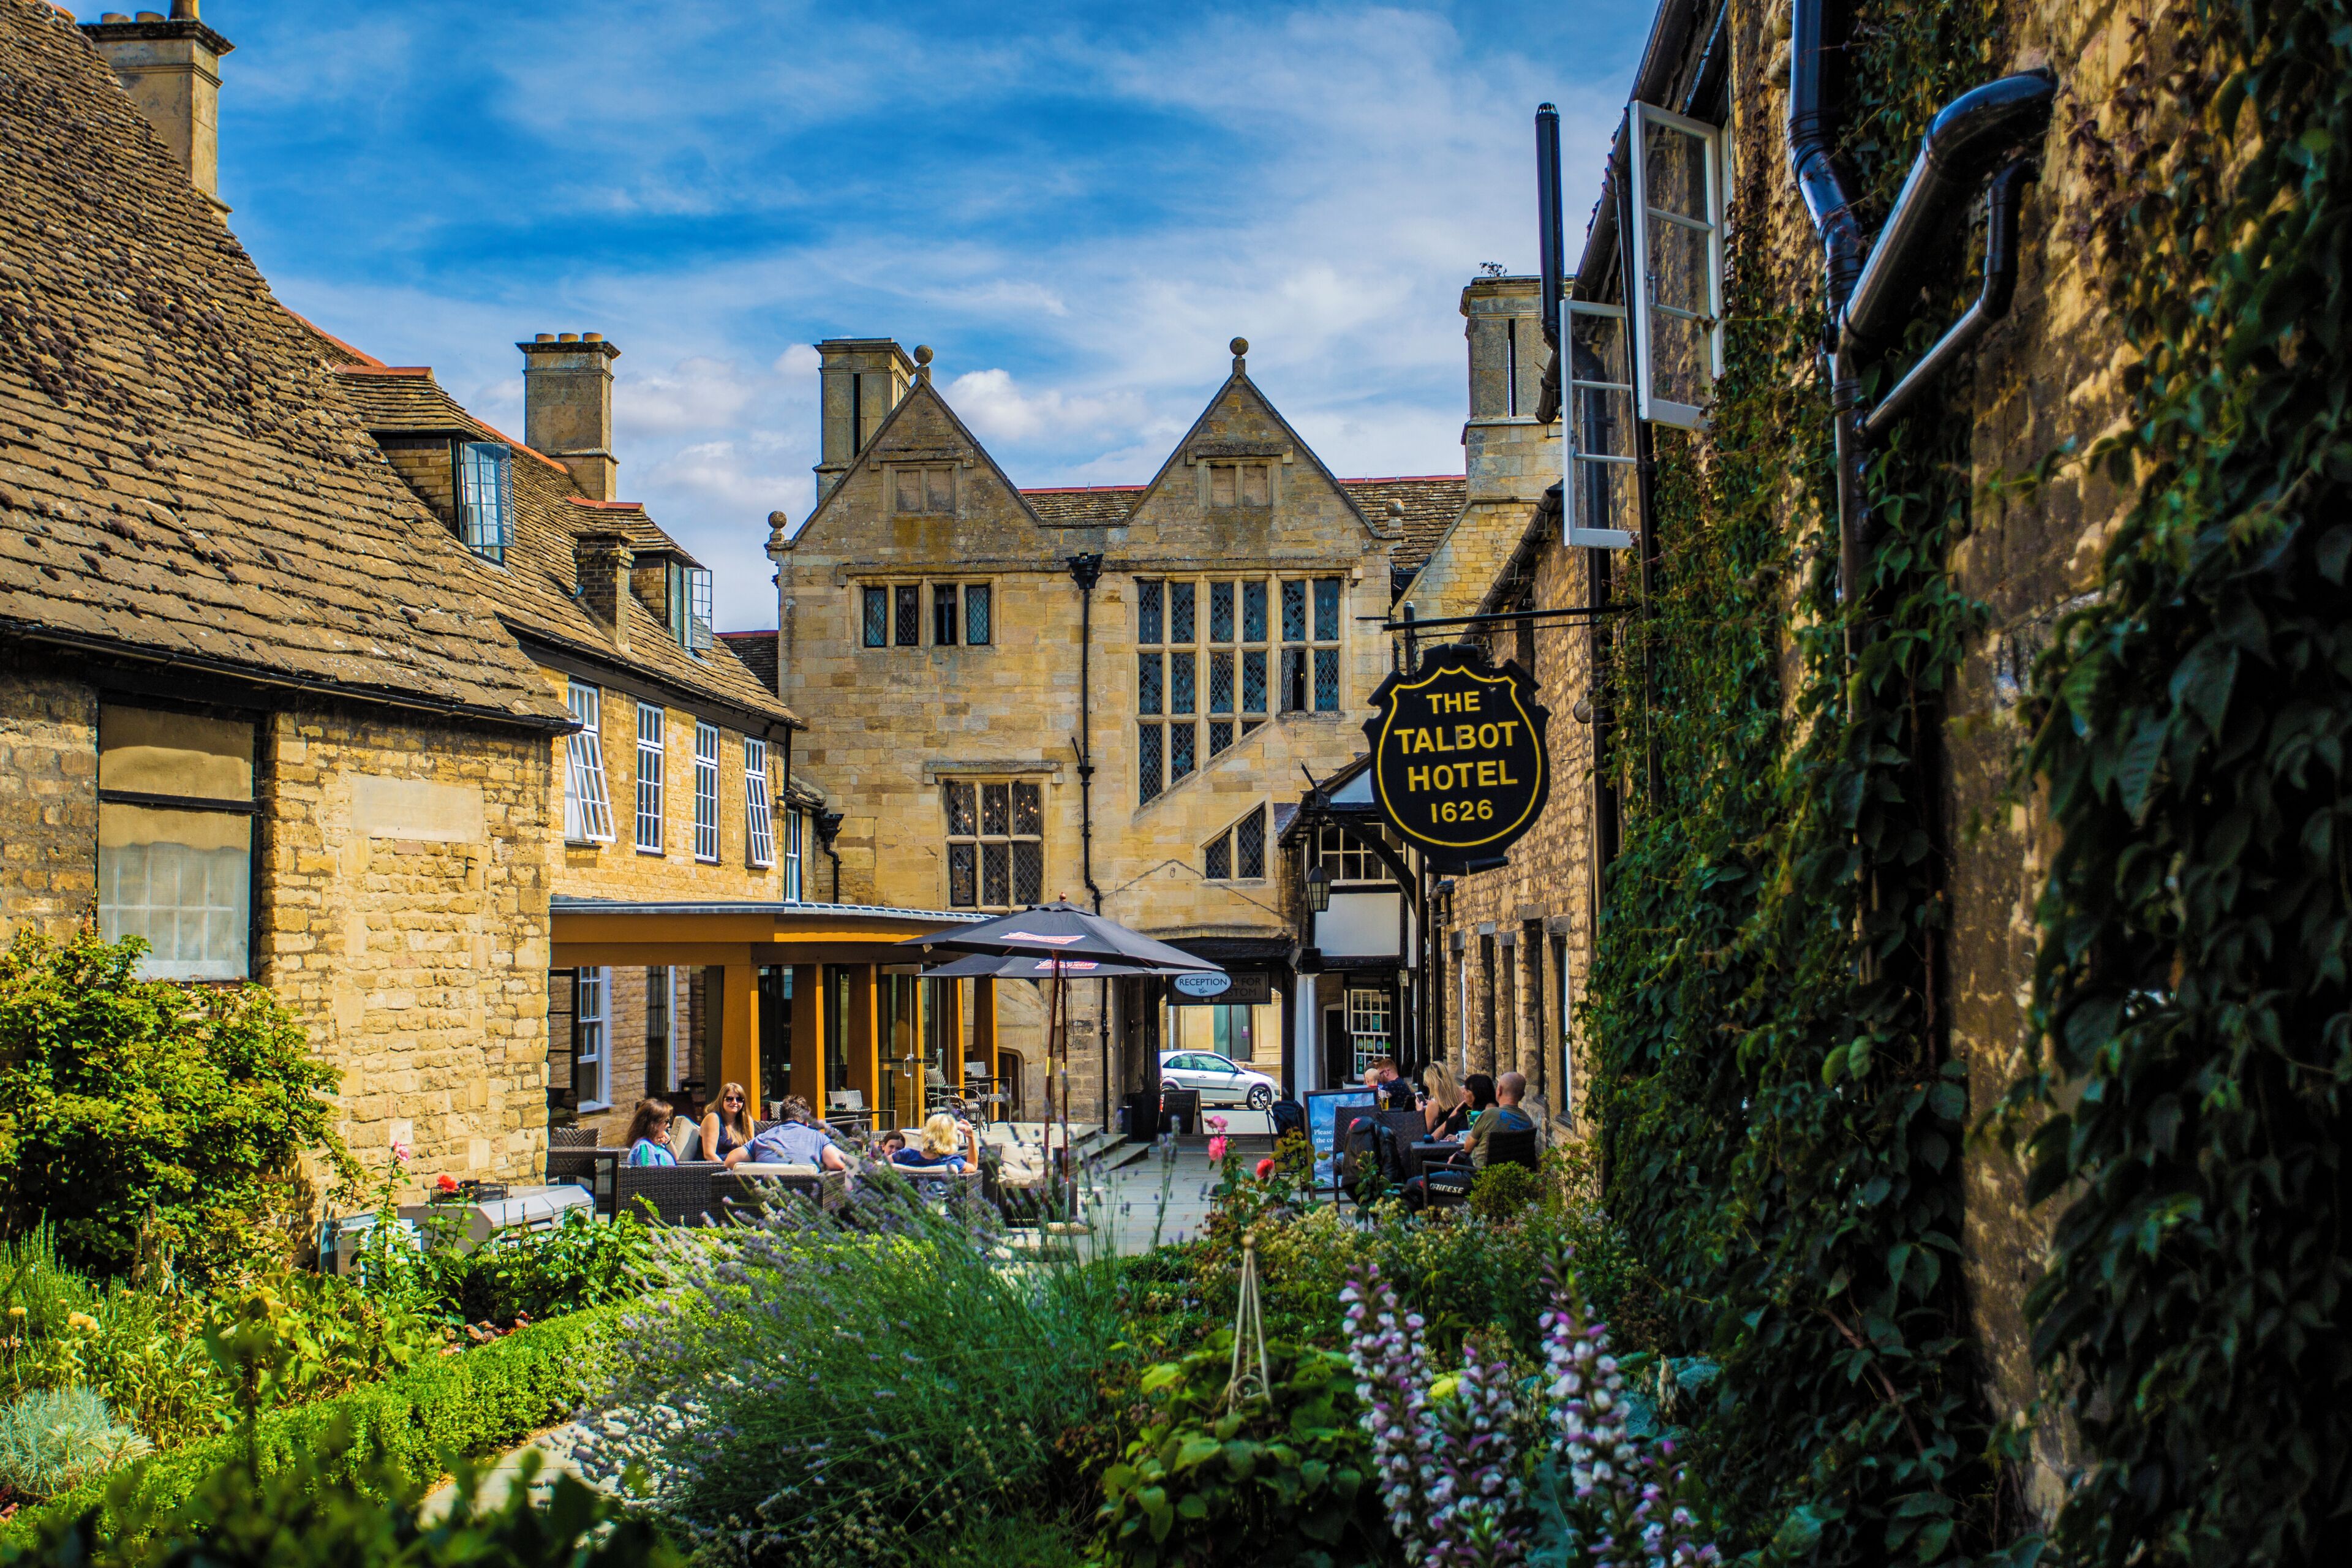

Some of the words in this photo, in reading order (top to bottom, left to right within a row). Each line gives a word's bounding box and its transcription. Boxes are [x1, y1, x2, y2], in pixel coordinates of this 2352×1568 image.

[1426, 691, 1480, 714] THE
[1394, 721, 1518, 754] TALBOT
[1408, 760, 1518, 791] HOTEL
[1431, 799, 1493, 823] 1626
